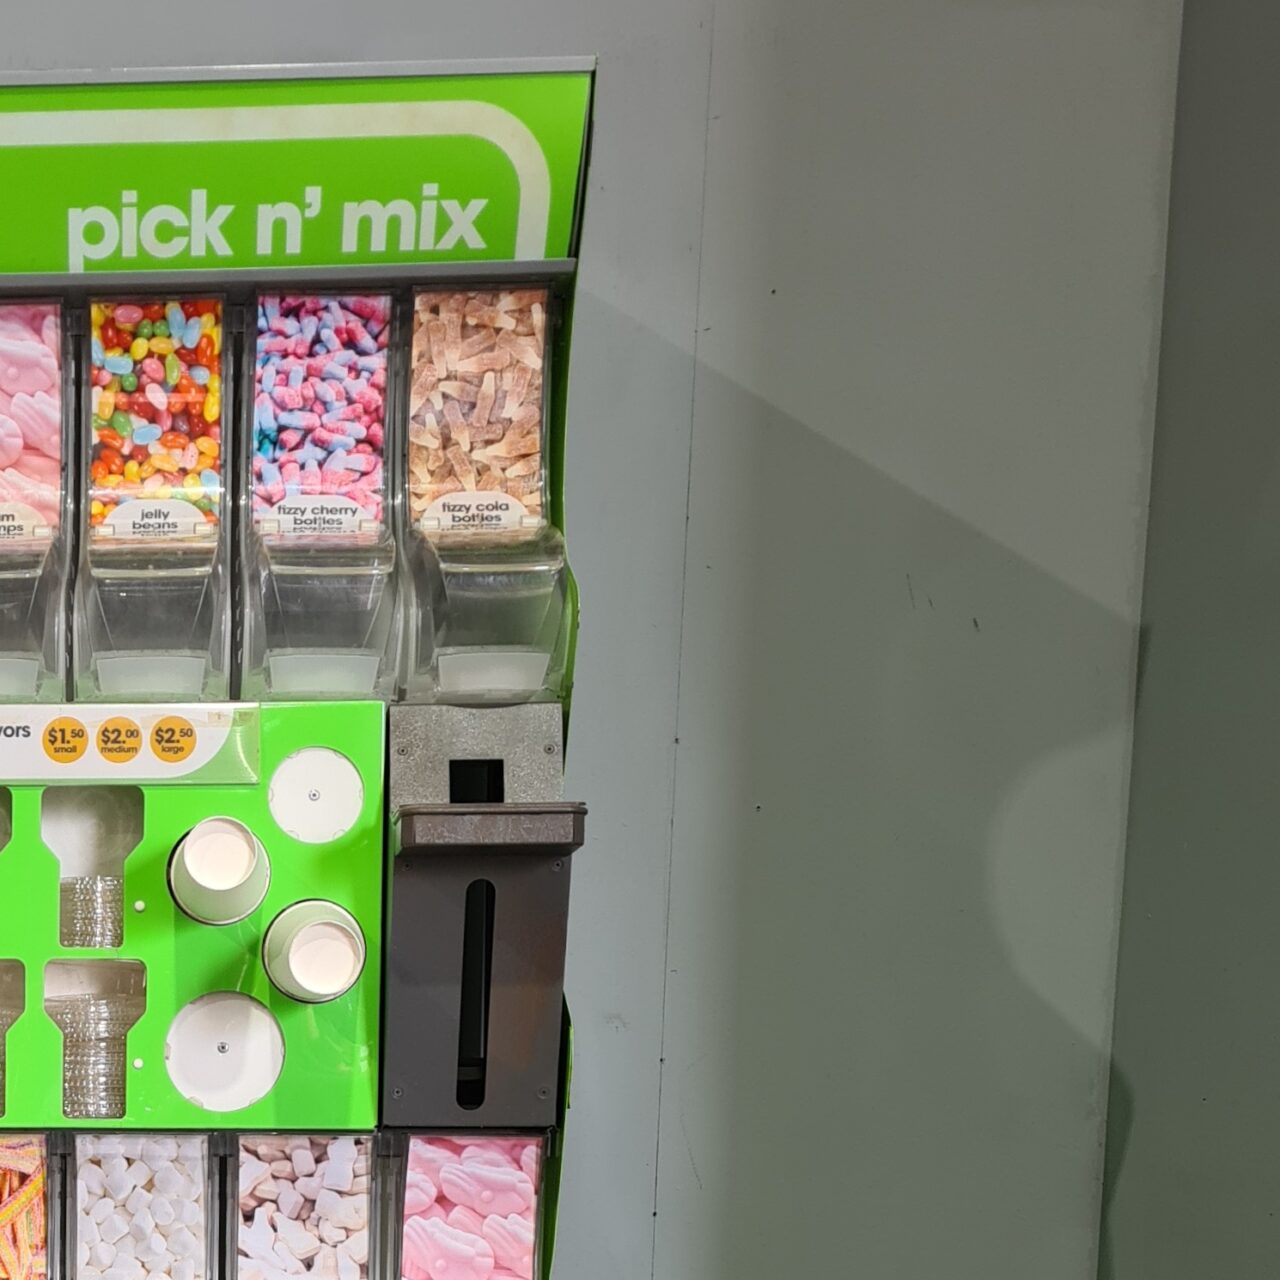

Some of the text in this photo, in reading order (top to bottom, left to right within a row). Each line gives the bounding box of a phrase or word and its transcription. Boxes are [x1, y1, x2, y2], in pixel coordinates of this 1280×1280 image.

[67, 188, 235, 274] pick
[342, 183, 489, 253] mix
[277, 505, 358, 517] fizzy cherry
[442, 500, 510, 514] fizzy cola
[140, 508, 170, 521] jelly
[132, 520, 179, 530] beans
[53, 744, 77, 753] small
[101, 744, 138, 753] medium
[161, 744, 185, 755] large
